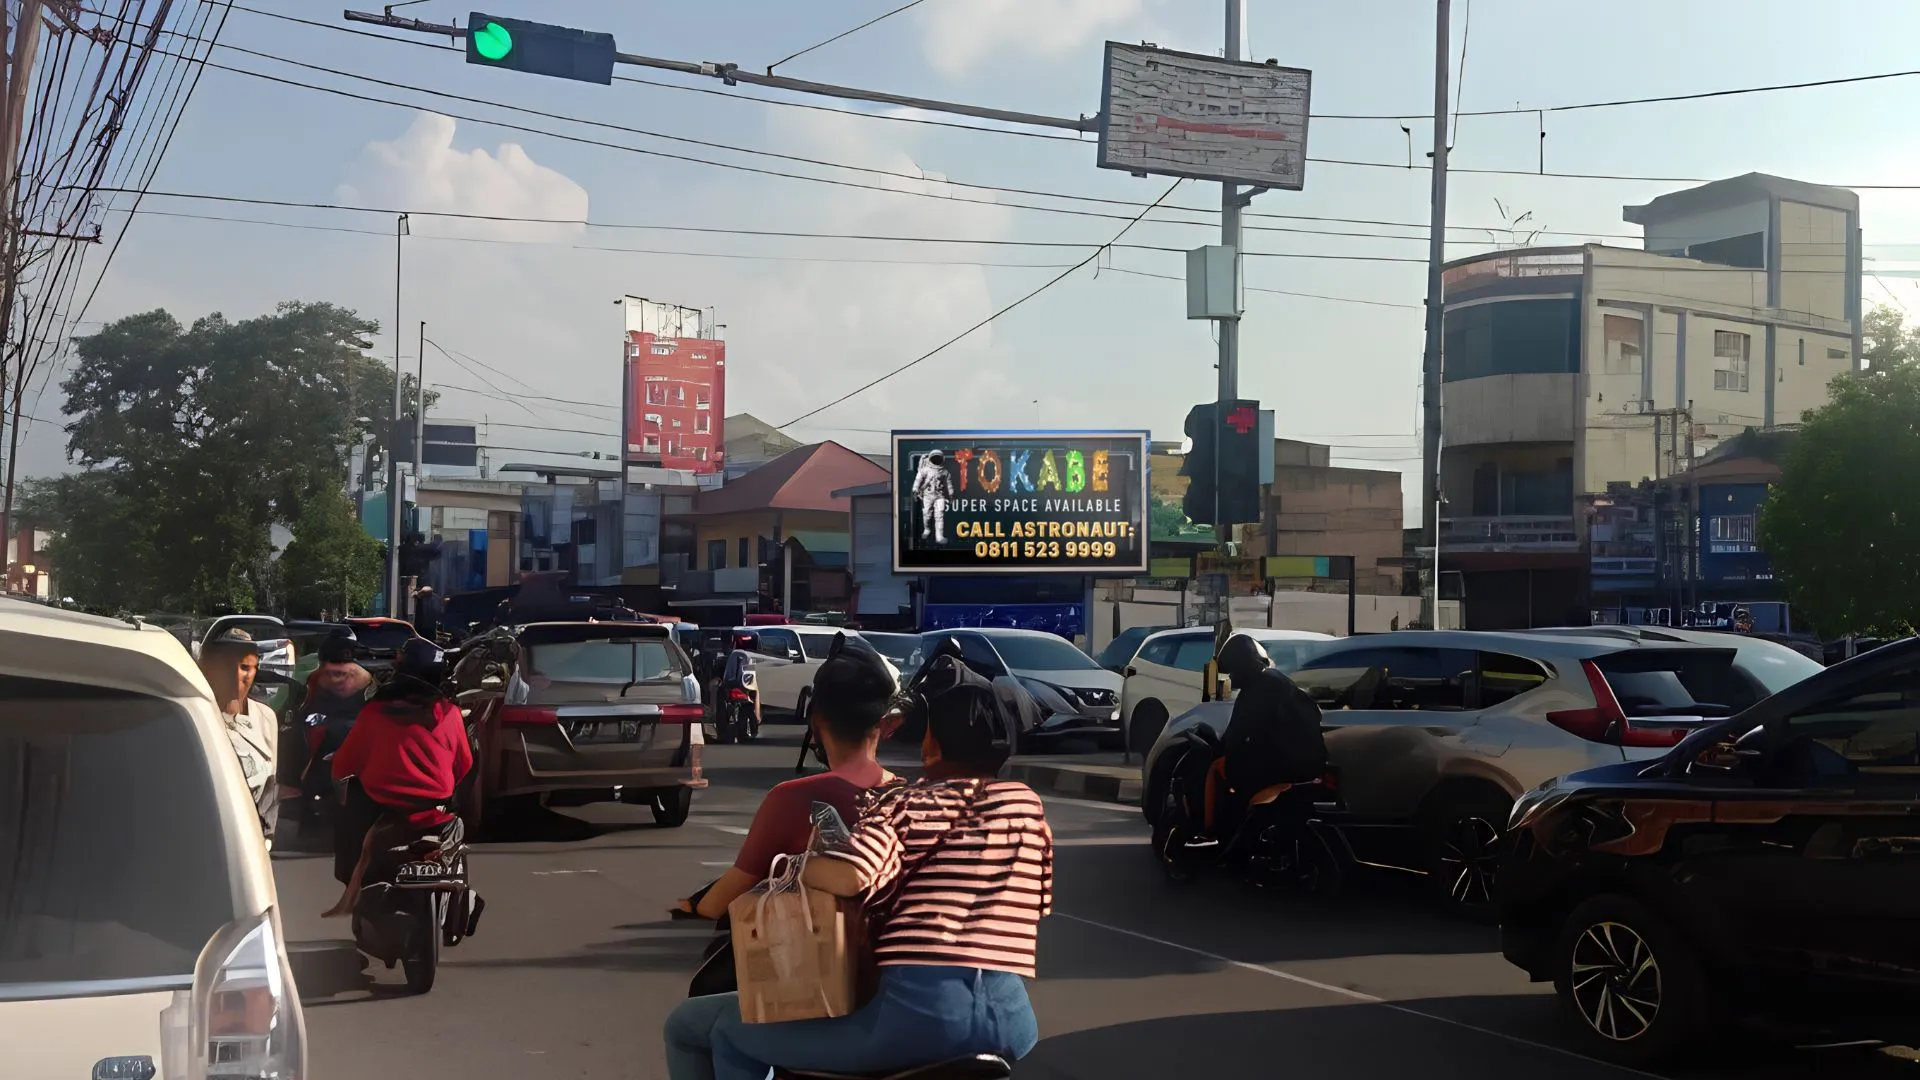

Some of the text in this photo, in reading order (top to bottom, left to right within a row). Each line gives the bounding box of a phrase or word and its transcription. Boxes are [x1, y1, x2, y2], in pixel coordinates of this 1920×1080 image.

[954, 449, 1109, 493] TOKABE
[994, 499, 1038, 512] SPACE
[1045, 499, 1121, 512] AVAILABLE
[956, 521, 1135, 538] CALL ASTRONAUT:
[975, 541, 1117, 558] 0811 523 9999
